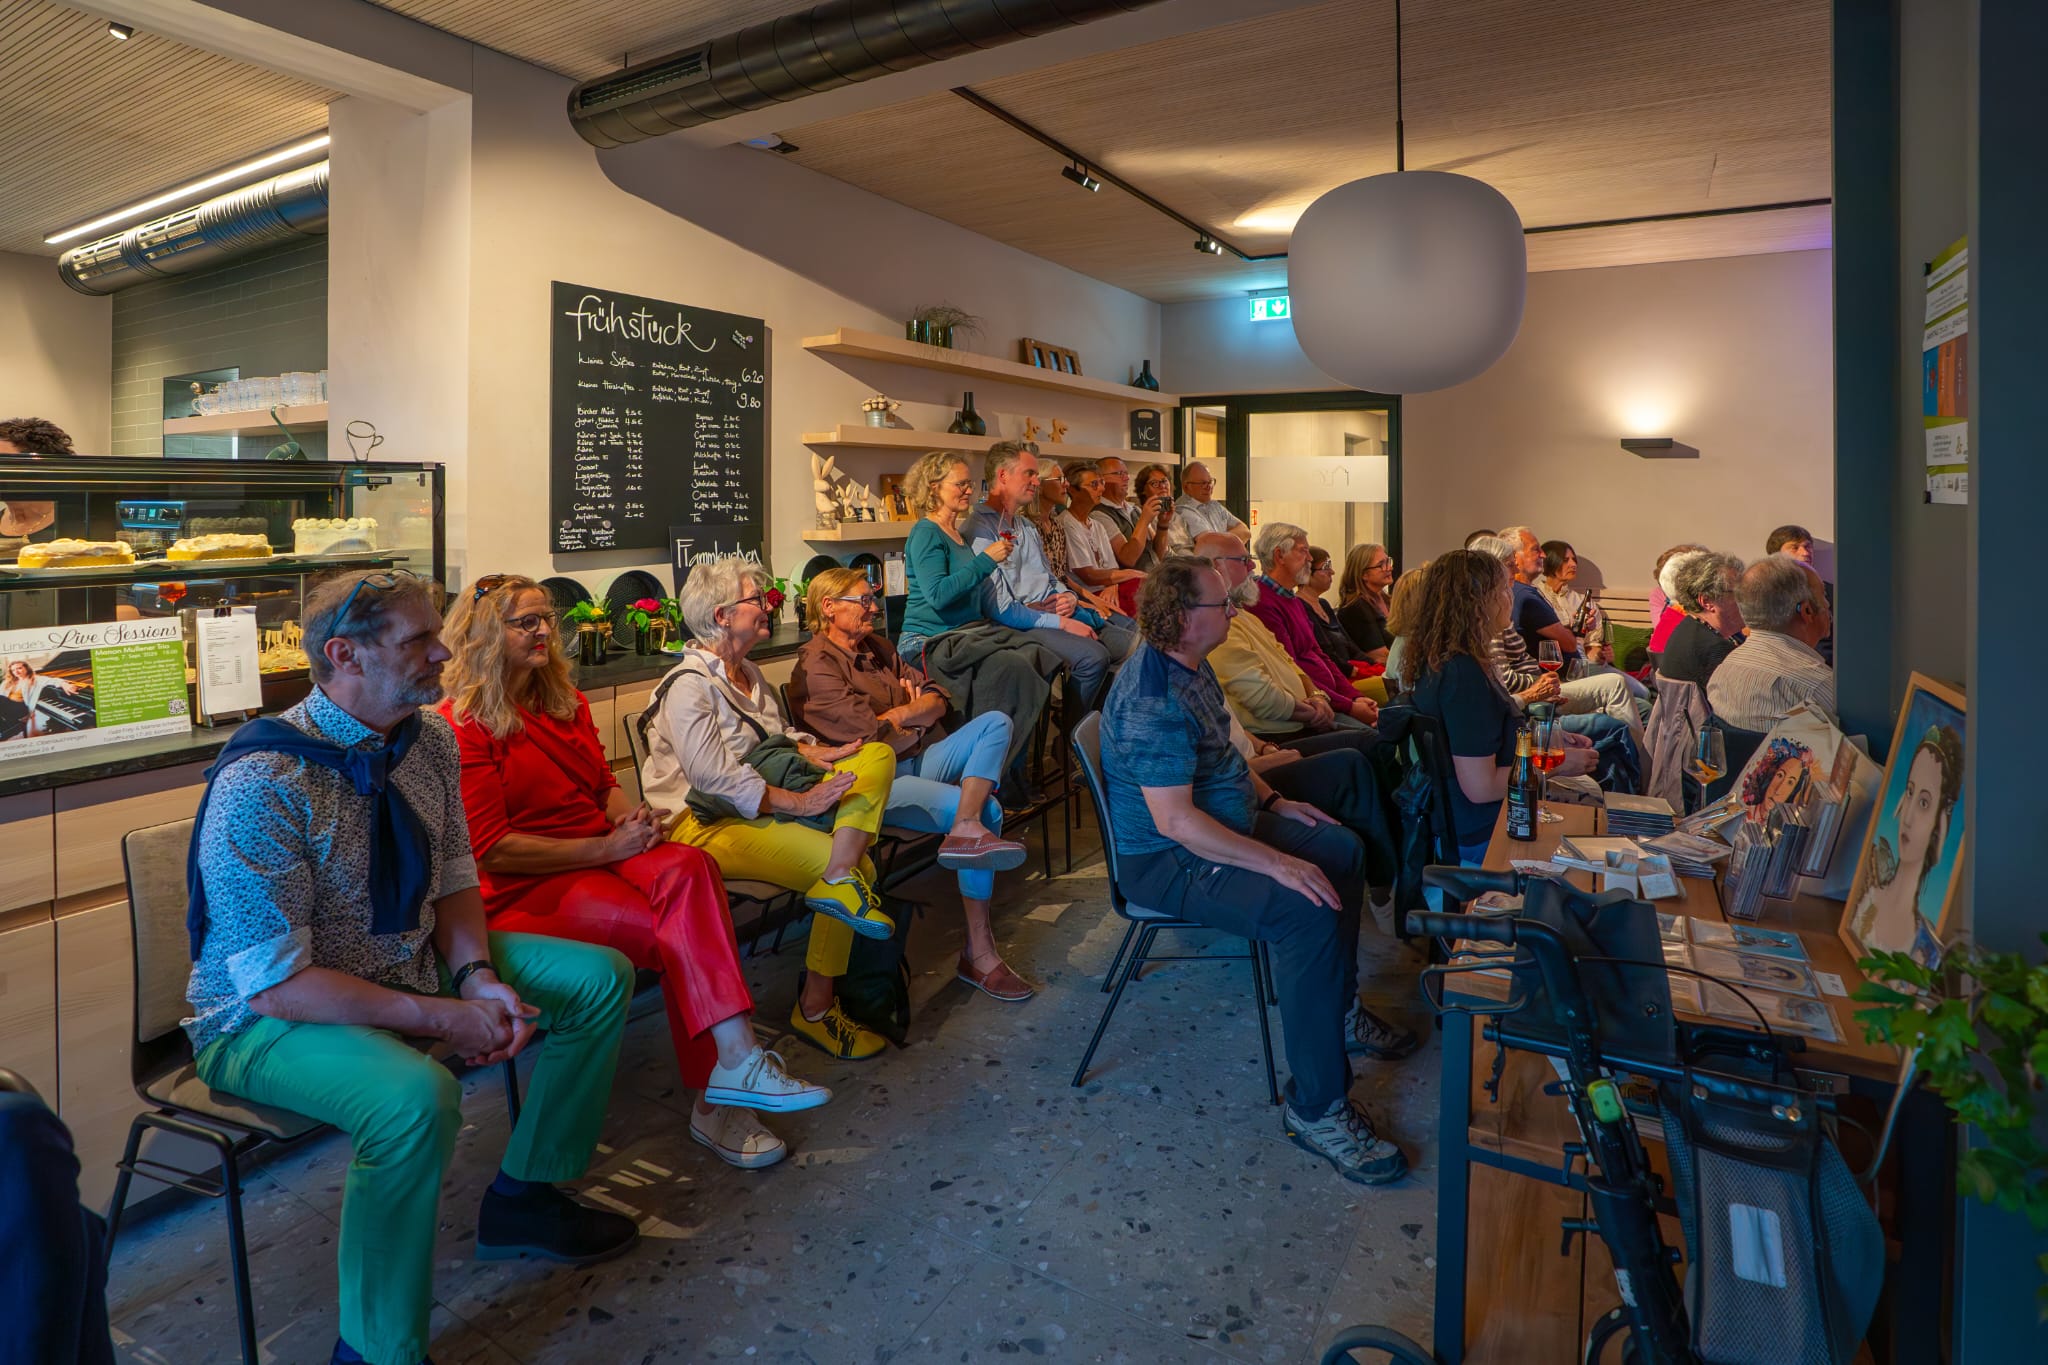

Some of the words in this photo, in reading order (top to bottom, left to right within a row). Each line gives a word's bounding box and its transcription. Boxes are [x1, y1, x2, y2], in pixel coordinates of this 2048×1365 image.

[741, 367, 764, 384] 6.20
[737, 393, 761, 409] 9.80
[1138, 425, 1156, 441] WC
[48, 630, 98, 650] Live
[103, 624, 177, 645] Sessions
